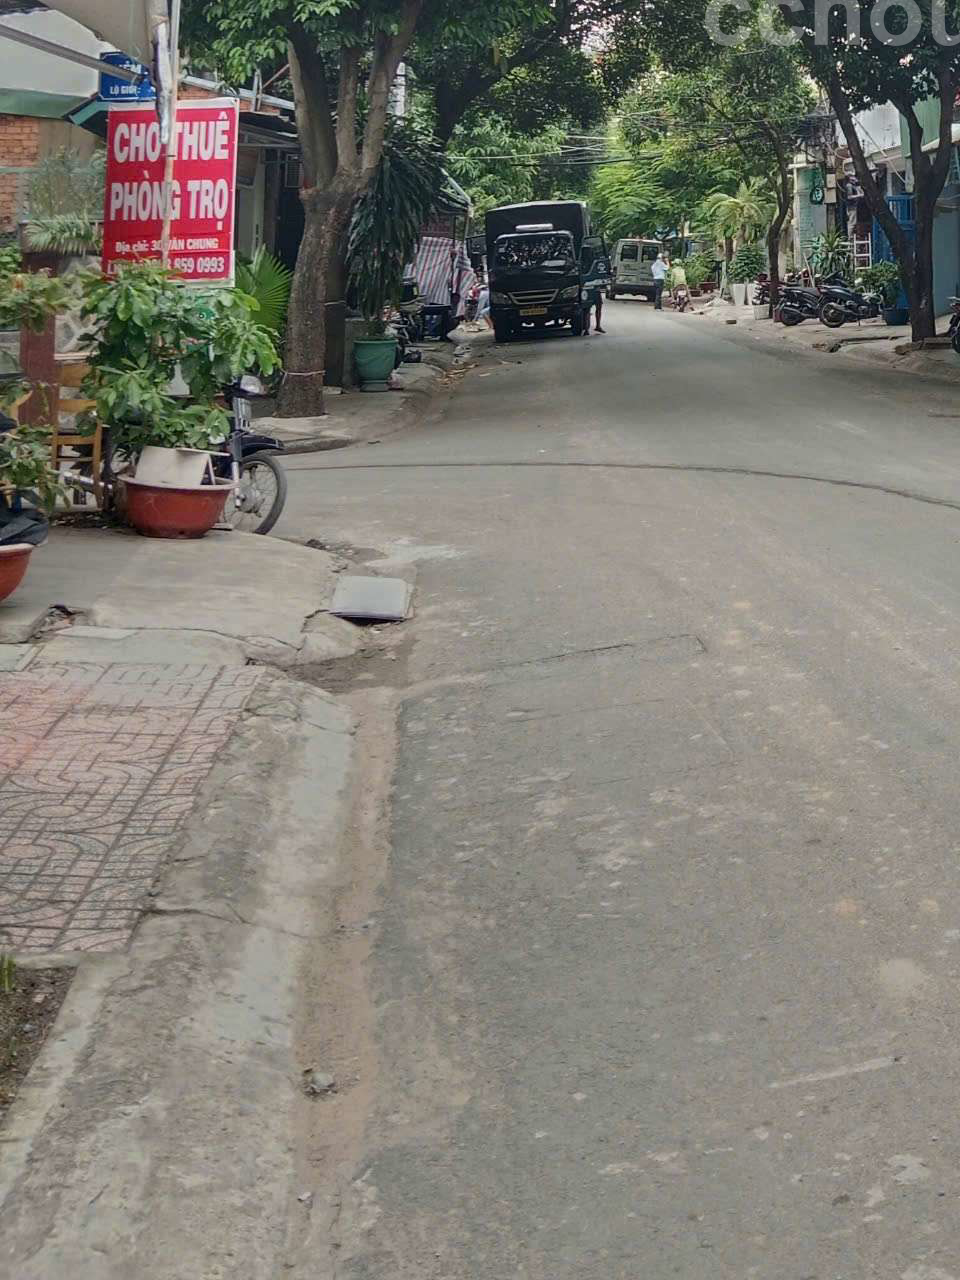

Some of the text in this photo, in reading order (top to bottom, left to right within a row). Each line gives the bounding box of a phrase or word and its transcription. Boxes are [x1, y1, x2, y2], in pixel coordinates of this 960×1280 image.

[114, 111, 230, 163] CHO THUÊ
[110, 170, 228, 231] PHÒNG TRỌ
[115, 241, 130, 254] Địa
[187, 238, 219, 249] CHUNG
[197, 257, 224, 272] 0993
